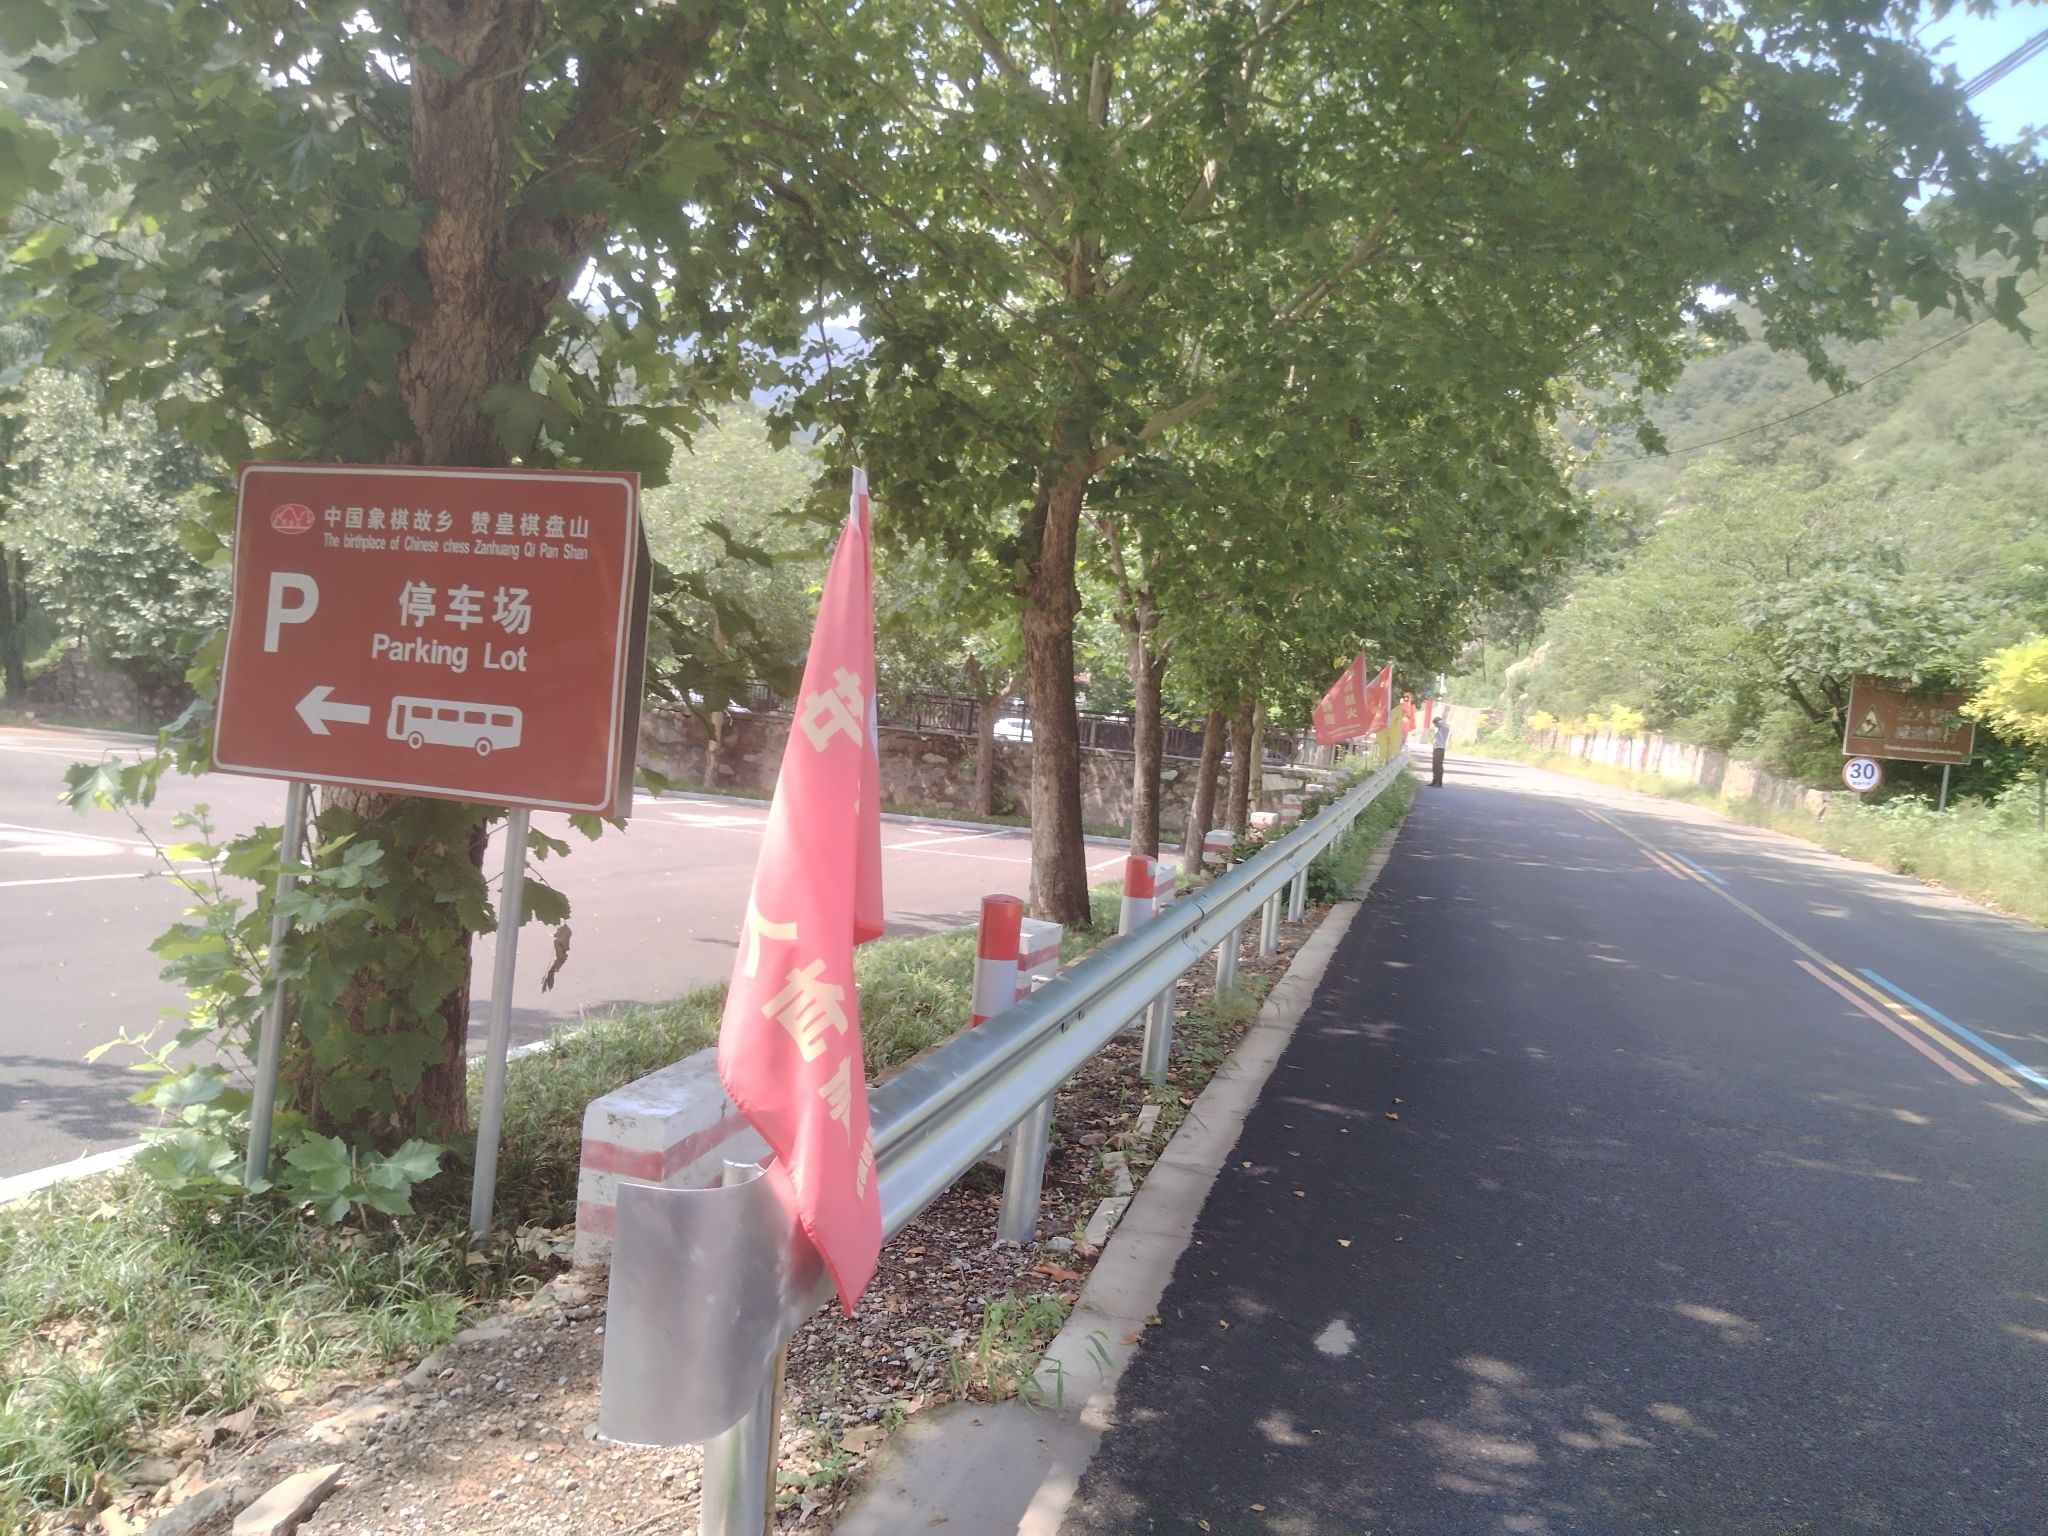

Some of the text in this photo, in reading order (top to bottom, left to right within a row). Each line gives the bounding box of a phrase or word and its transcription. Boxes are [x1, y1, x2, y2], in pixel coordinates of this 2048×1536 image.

[324, 505, 589, 540] 中国象棋故乡 赞皇棋盘山
[324, 532, 588, 560] The birthplace of Chinese chess Zanhuang Qi Pan Shan
[263, 571, 320, 653] P
[398, 580, 532, 636] 停车场
[371, 633, 528, 673] Parking Lot
[1850, 763, 1875, 780] 30
